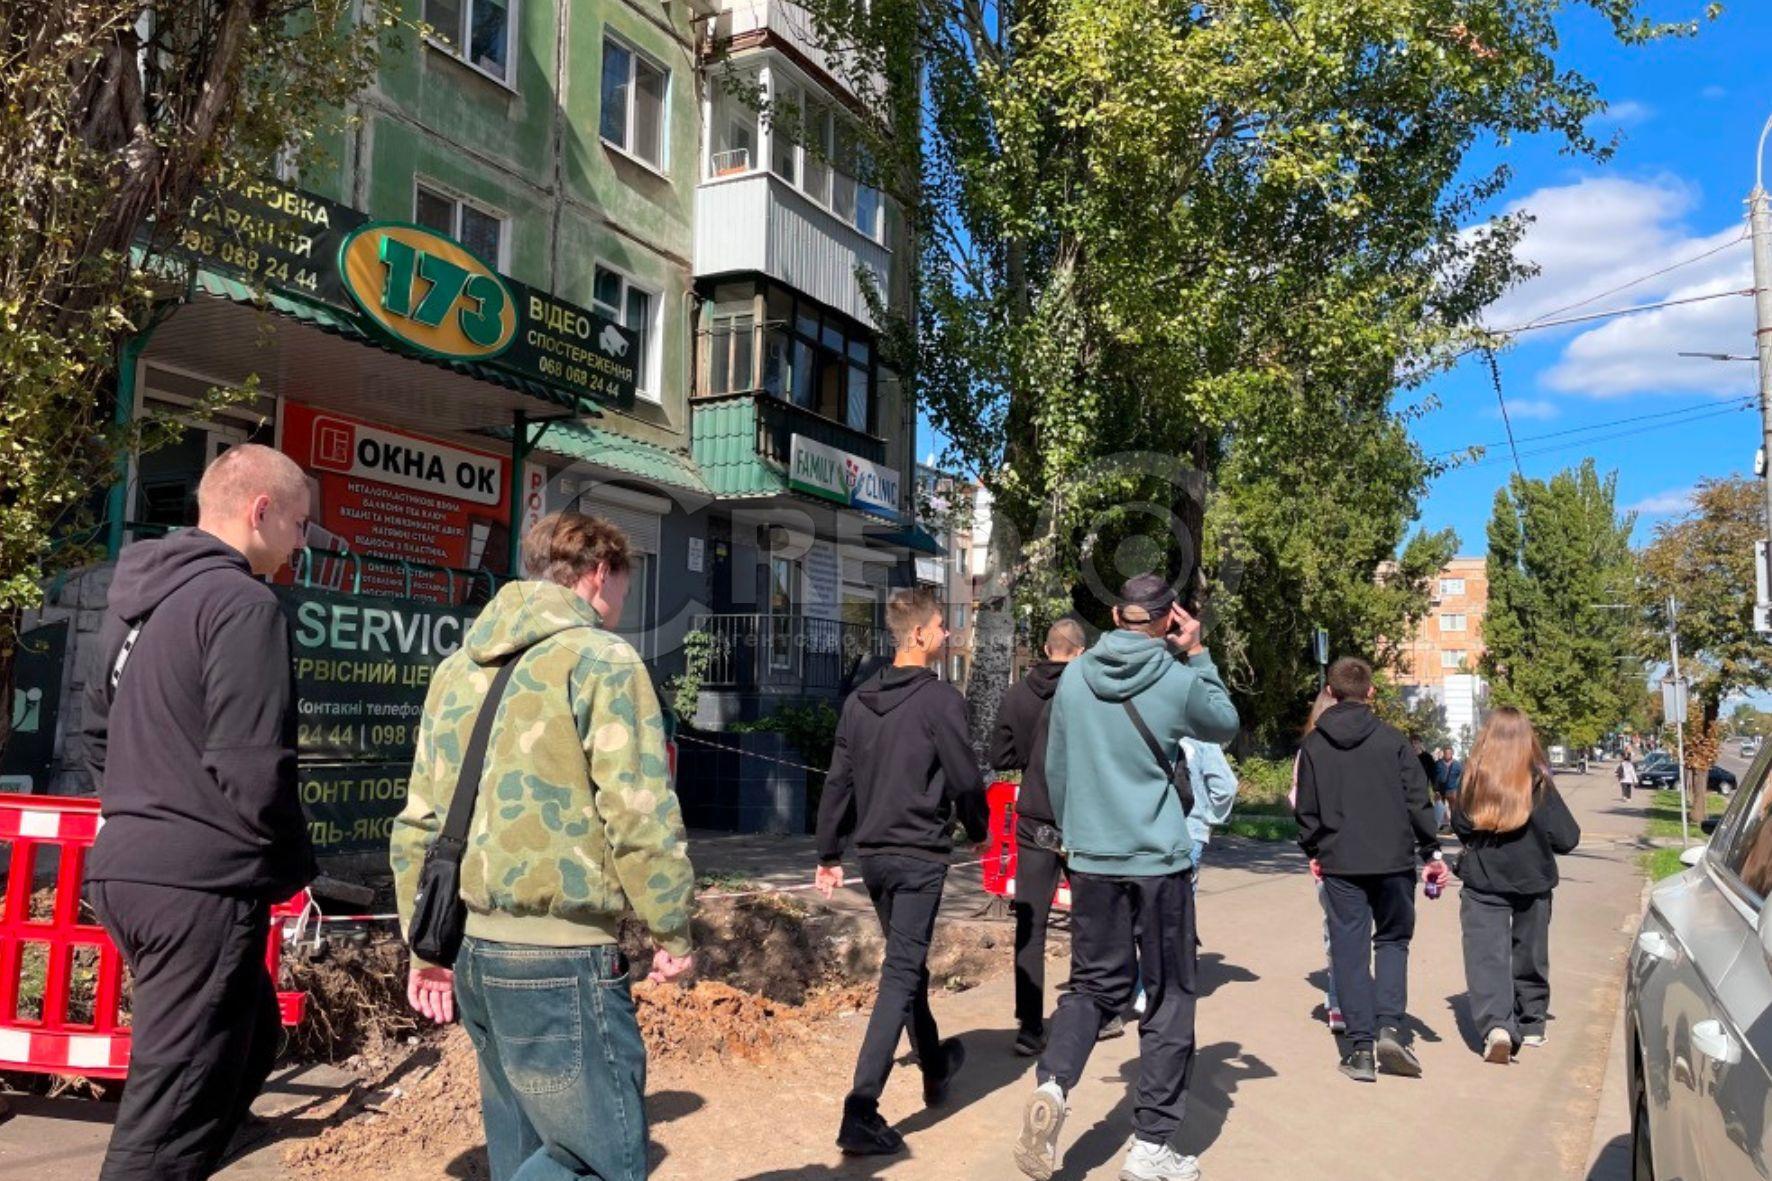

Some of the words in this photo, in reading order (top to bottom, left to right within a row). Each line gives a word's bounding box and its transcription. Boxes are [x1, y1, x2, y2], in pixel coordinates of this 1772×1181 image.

[265, 257, 289, 282] 24
[294, 268, 318, 292] 44
[379, 235, 505, 348] 173
[530, 295, 591, 340] ВІДЕО
[528, 330, 633, 382] СПОСТЕРЕЖЕННЯ
[539, 356, 562, 378] 068
[590, 374, 604, 392] 24
[606, 381, 620, 398] 44
[357, 438, 447, 484] ОКНА
[456, 462, 496, 495] ОК
[797, 449, 835, 486] FAMILY
[866, 473, 897, 505] CLINIC
[293, 657, 397, 685] РВІСНИЙ
[402, 663, 434, 689] ЦЕ
[367, 700, 422, 719] телефо
[298, 723, 322, 746] 24
[328, 724, 353, 746] 44
[372, 724, 406, 746] 098
[298, 781, 354, 804] ОНТ
[307, 817, 395, 848] ДЬ-ЯКО
